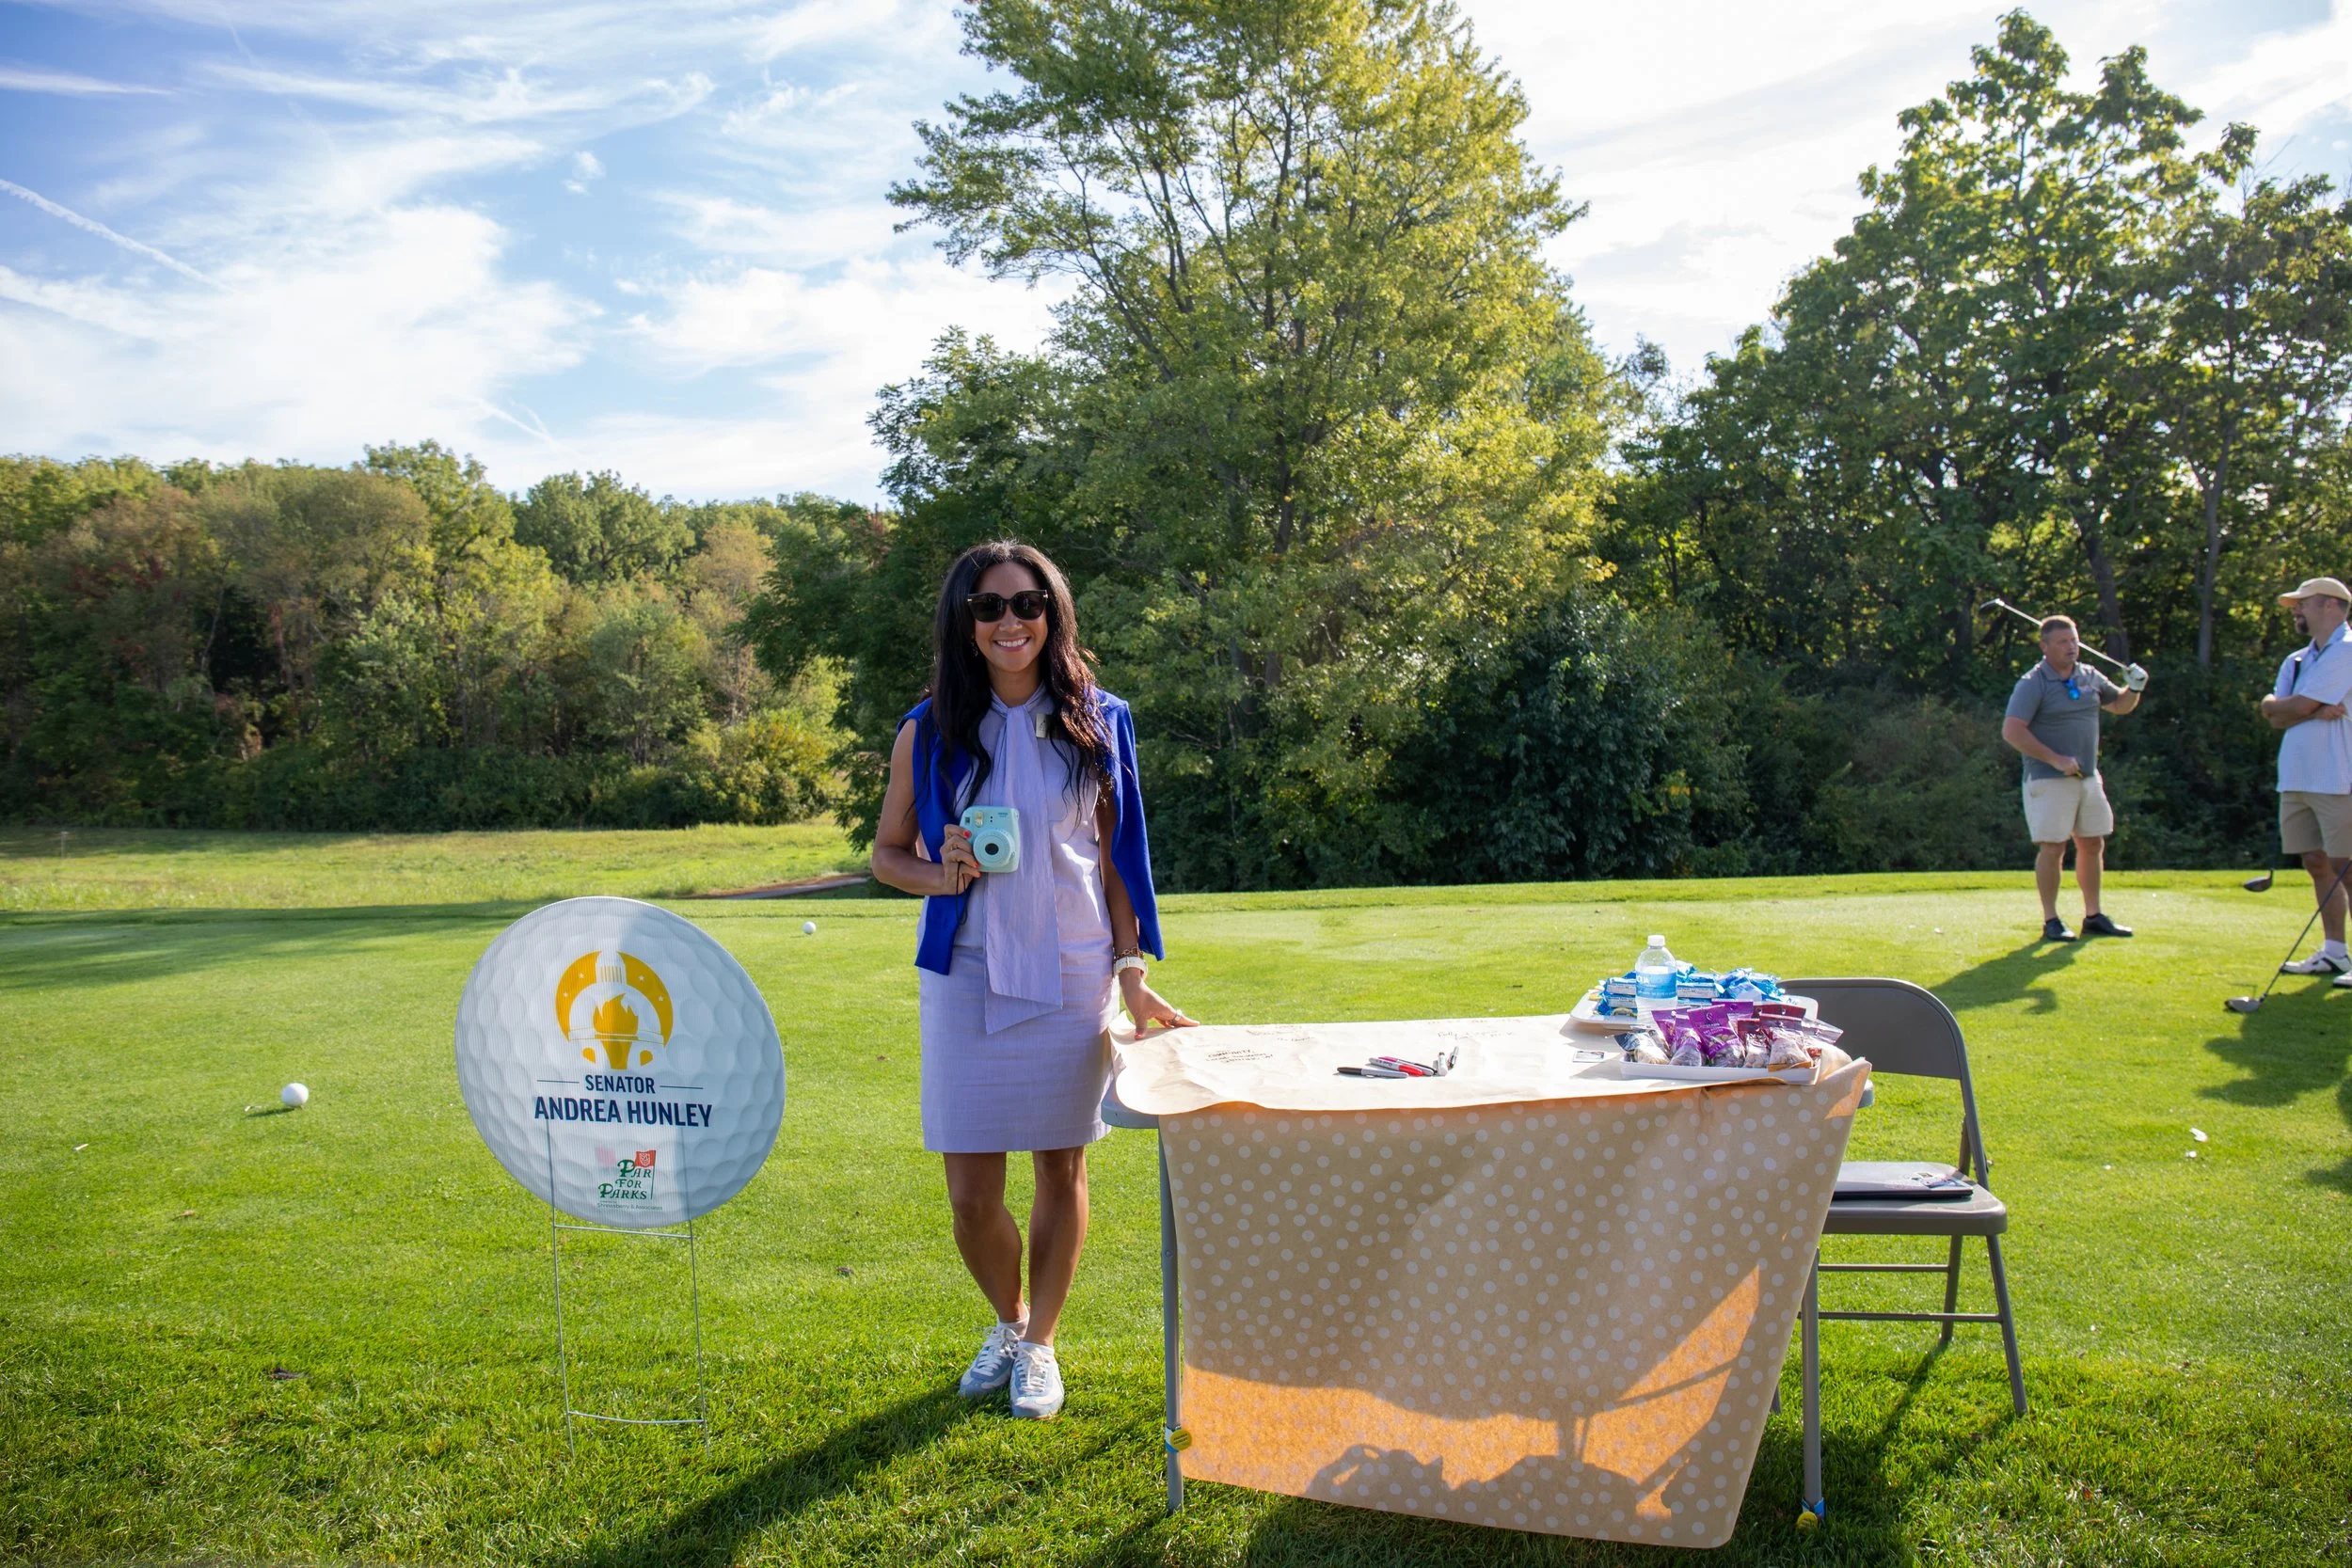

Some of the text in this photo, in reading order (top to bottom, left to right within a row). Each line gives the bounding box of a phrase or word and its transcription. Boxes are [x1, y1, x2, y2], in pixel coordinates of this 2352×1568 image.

[584, 1074, 656, 1094] SENATOR
[534, 1096, 713, 1128] ANDREA HUNLEY
[597, 1182, 647, 1200] PARKS
[615, 1178, 642, 1189] FOR
